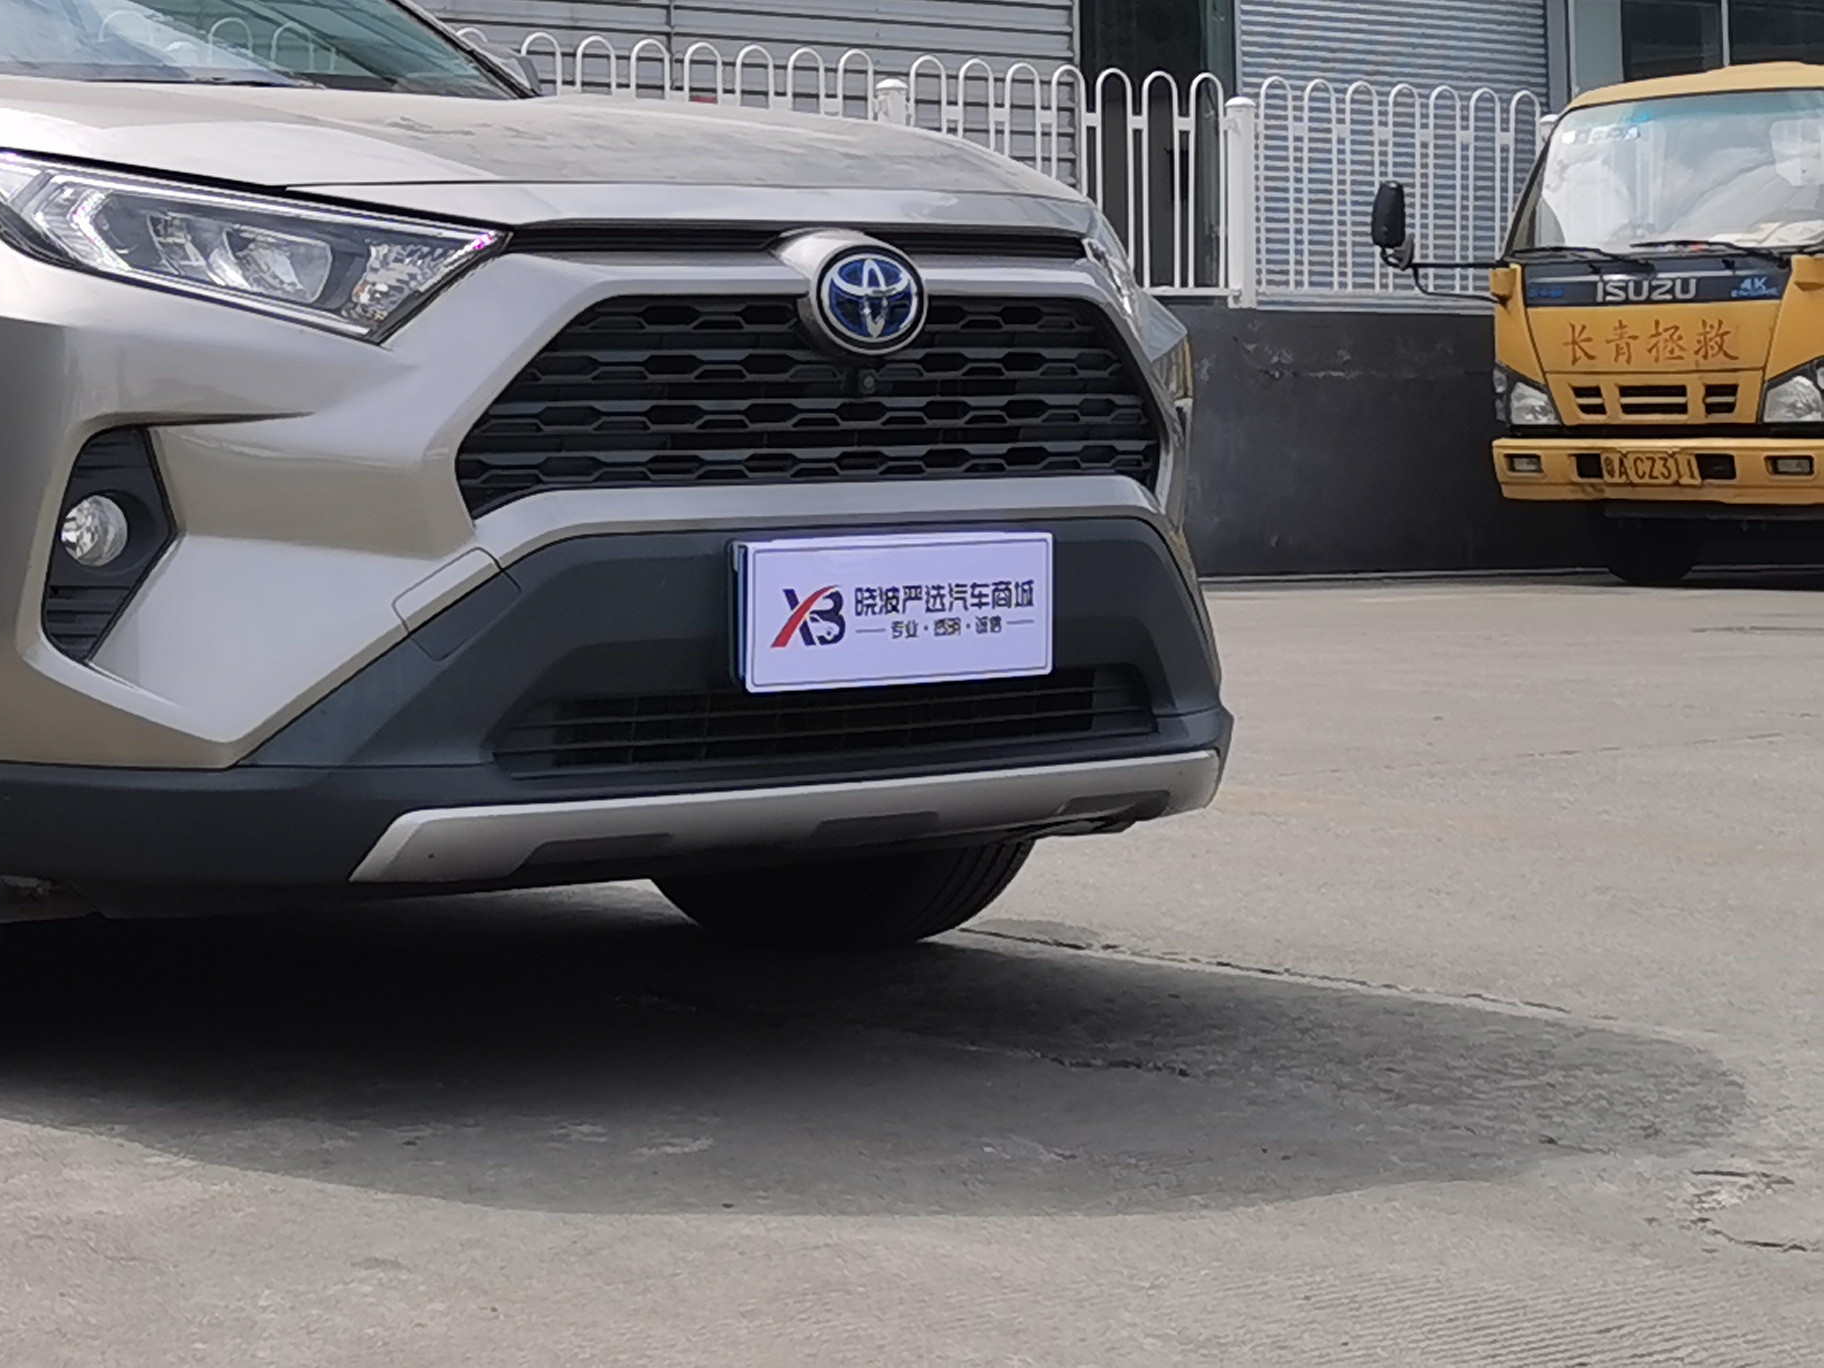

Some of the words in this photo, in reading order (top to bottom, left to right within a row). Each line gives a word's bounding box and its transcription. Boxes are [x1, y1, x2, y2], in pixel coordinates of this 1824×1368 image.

[1596, 279, 1697, 302] ISUZU
[1563, 319, 1739, 366] 长青拯救
[855, 580, 1035, 616] 晓波严选汽车商城
